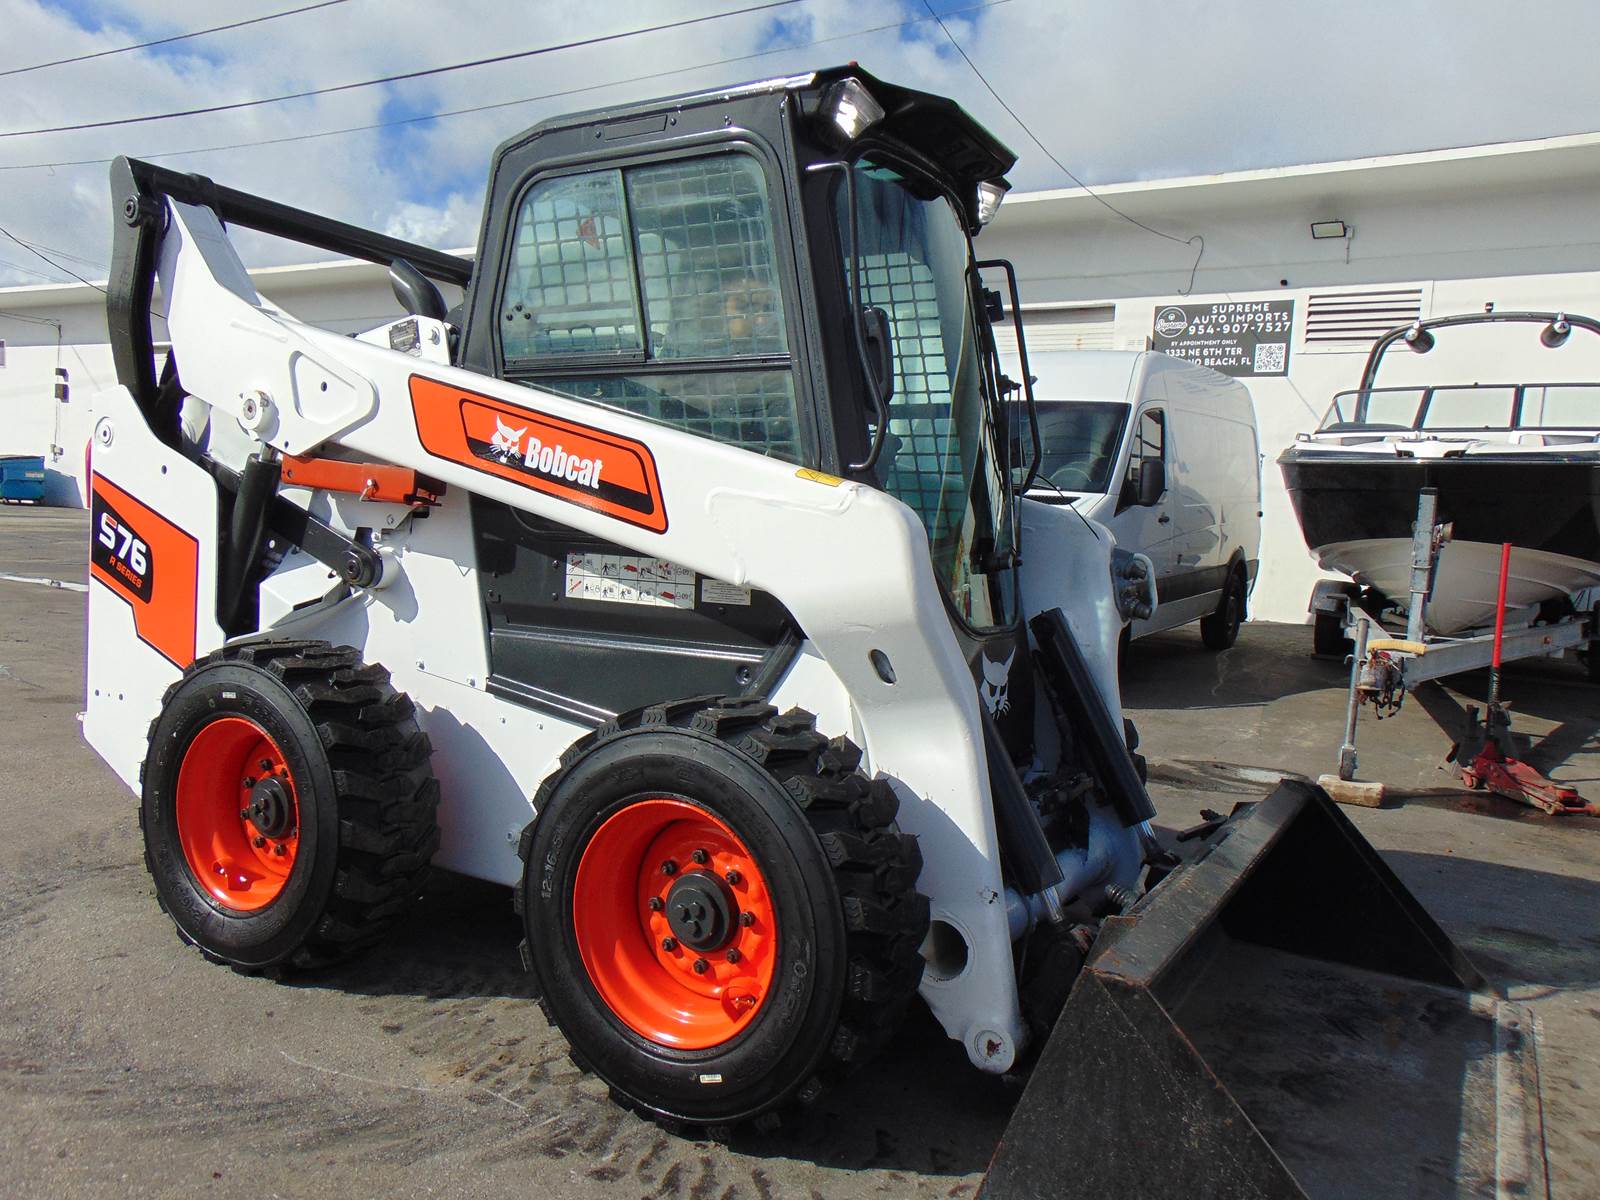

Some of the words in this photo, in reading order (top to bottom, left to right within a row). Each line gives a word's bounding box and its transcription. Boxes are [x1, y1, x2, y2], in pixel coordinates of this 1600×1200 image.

[1212, 303, 1270, 314] SUPREME
[1193, 315, 1227, 324] AUTO
[1231, 312, 1289, 323] IMPORTS
[1188, 322, 1291, 335] 954-907-7527
[1188, 348, 1201, 356] NE
[1202, 347, 1222, 356] 6TH
[1225, 347, 1242, 355] TER
[1204, 357, 1238, 366] BEACH,
[1241, 357, 1252, 365] FL
[524, 437, 603, 489] Bobcat
[98, 512, 147, 575] S76
[116, 560, 142, 588] SERIES
